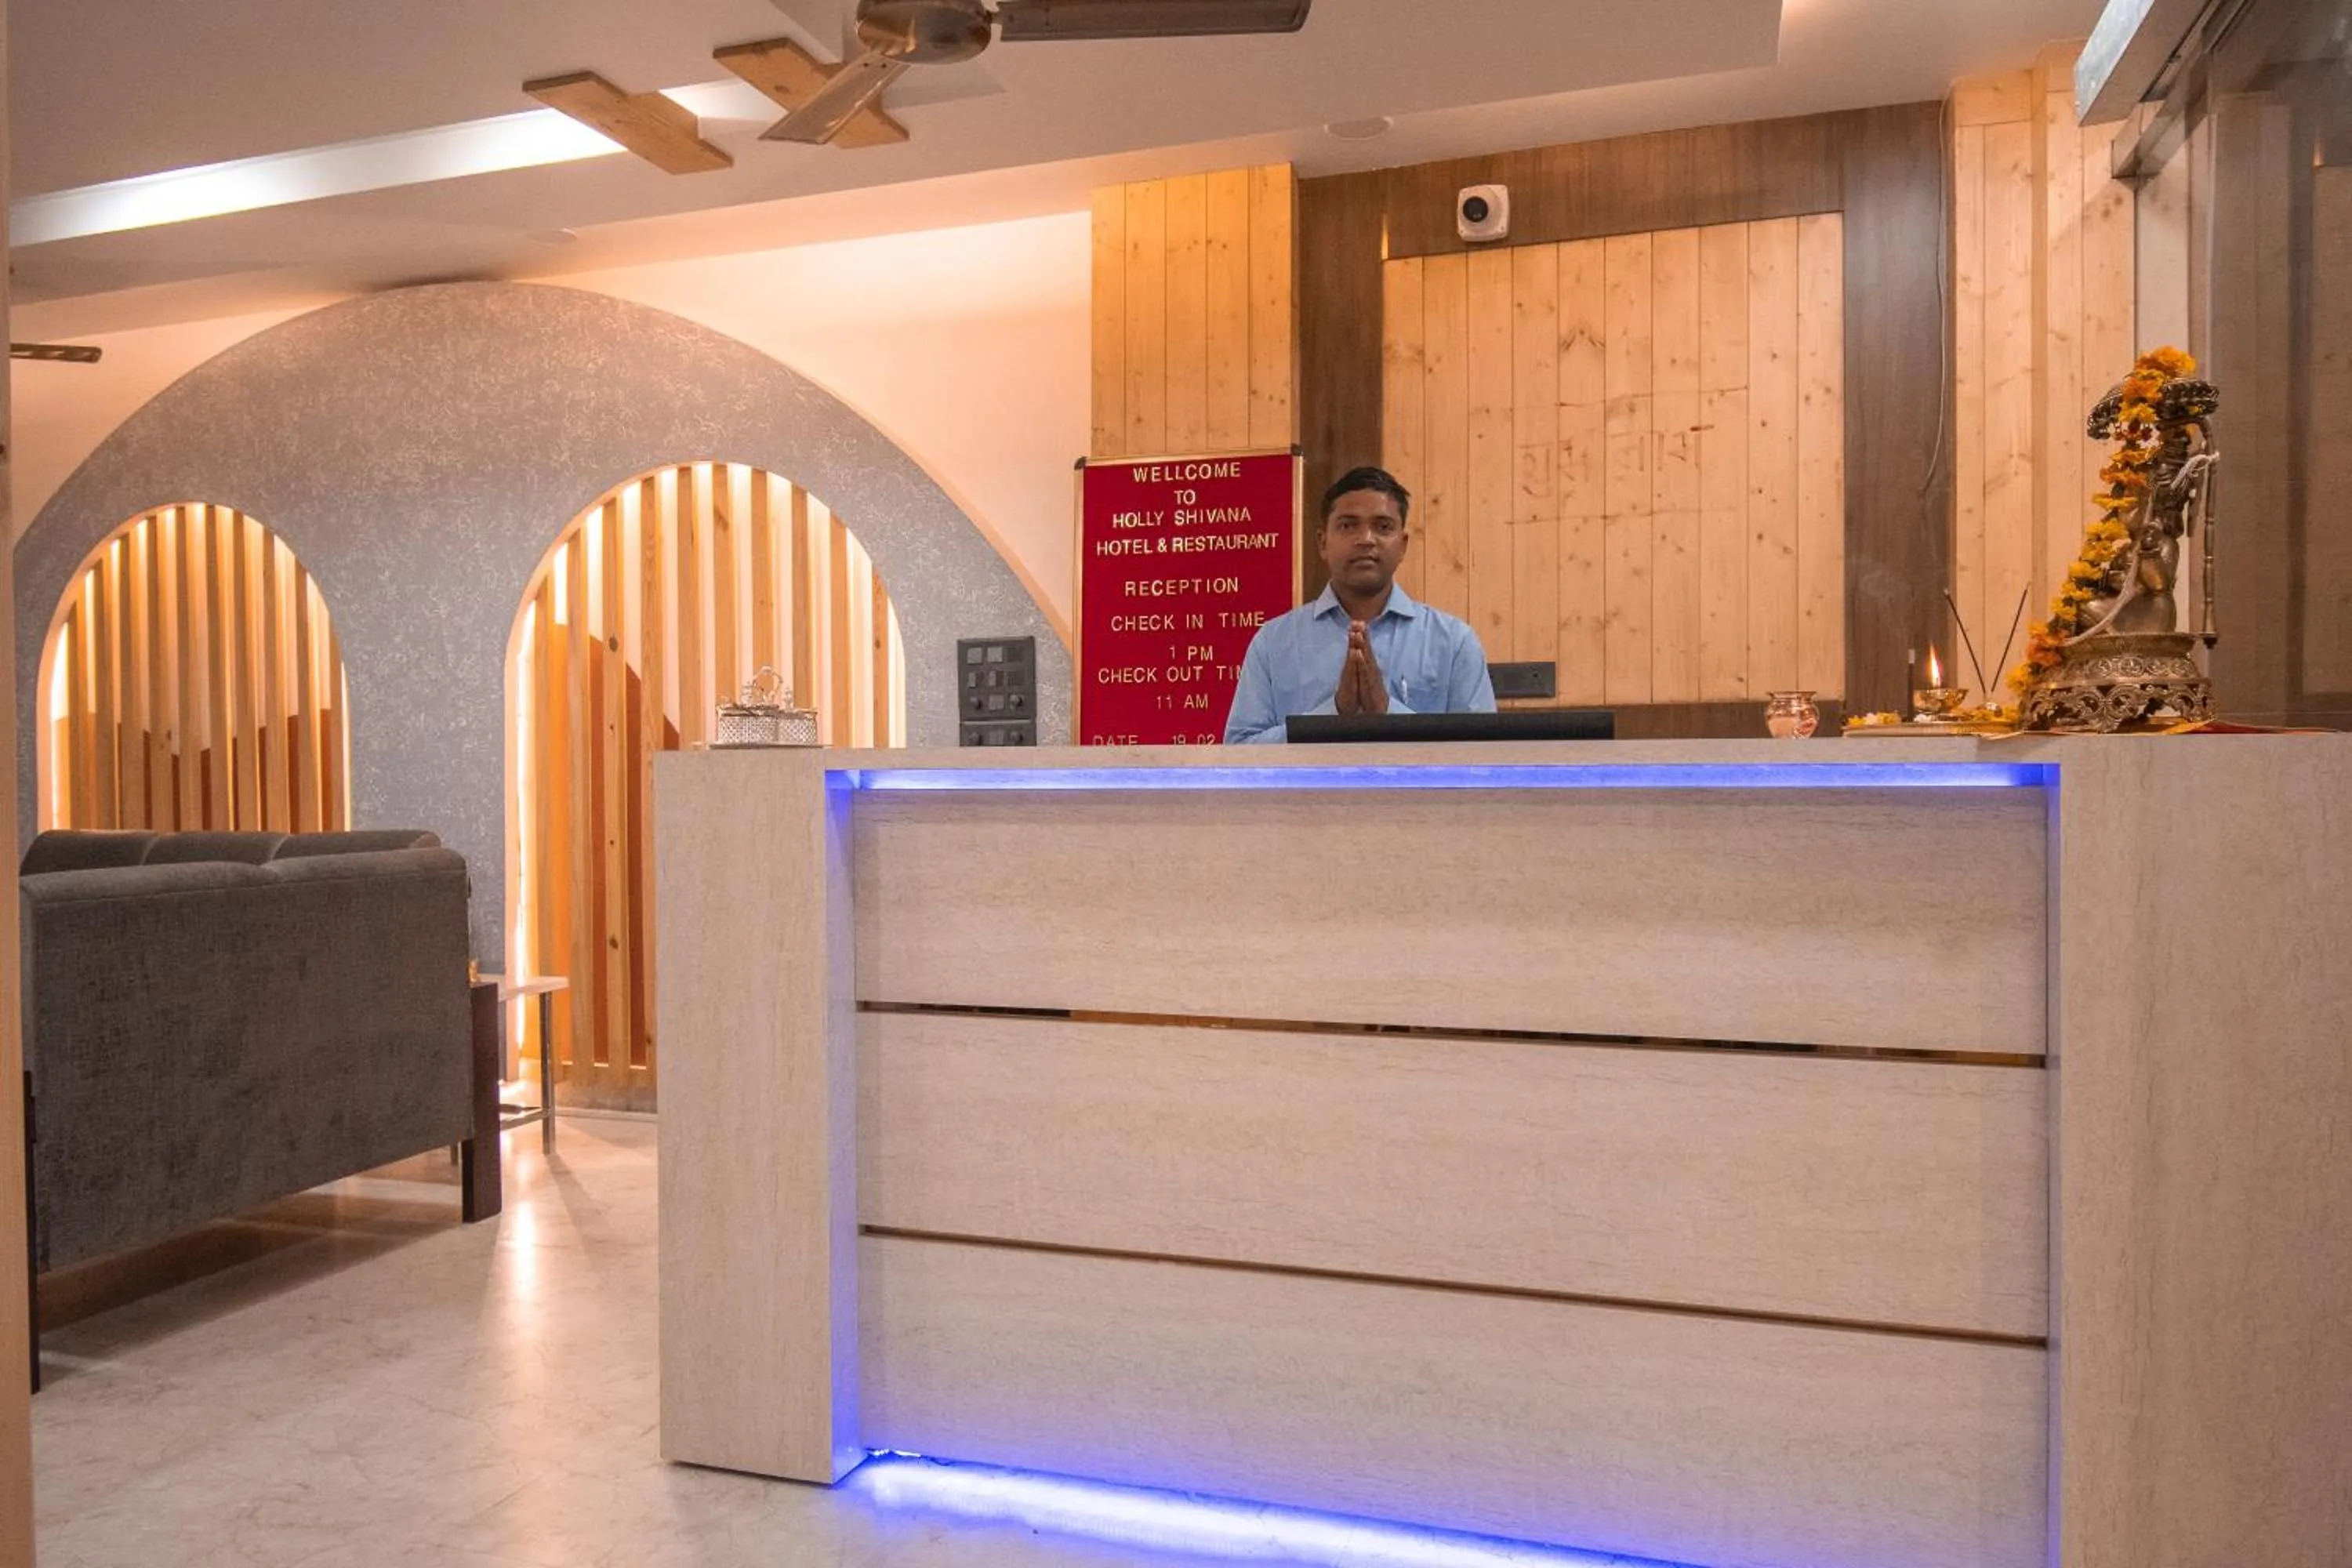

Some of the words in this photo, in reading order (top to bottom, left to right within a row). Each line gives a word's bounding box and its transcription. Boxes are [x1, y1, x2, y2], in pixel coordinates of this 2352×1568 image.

[1134, 463, 1241, 483] WELLCOME
[1174, 489, 1196, 506] TO
[1112, 511, 1164, 528] HOLLY
[1174, 507, 1251, 526] SHIVANA
[1097, 541, 1152, 556] HOTEL
[1157, 539, 1167, 553] &
[1172, 533, 1279, 552] RESTAURANT
[1125, 578, 1239, 597] RECEPTION
[1111, 615, 1174, 632] CHECK
[1186, 615, 1203, 628] IN
[1218, 612, 1265, 627] TIME
[1170, 646, 1175, 659] 1
[1188, 646, 1213, 661] PM
[1098, 668, 1157, 684] CHECK
[1166, 666, 1203, 682] OUT
[1156, 696, 1172, 710] 11
[1184, 694, 1208, 710] AM
[1093, 735, 1138, 745] DATE
